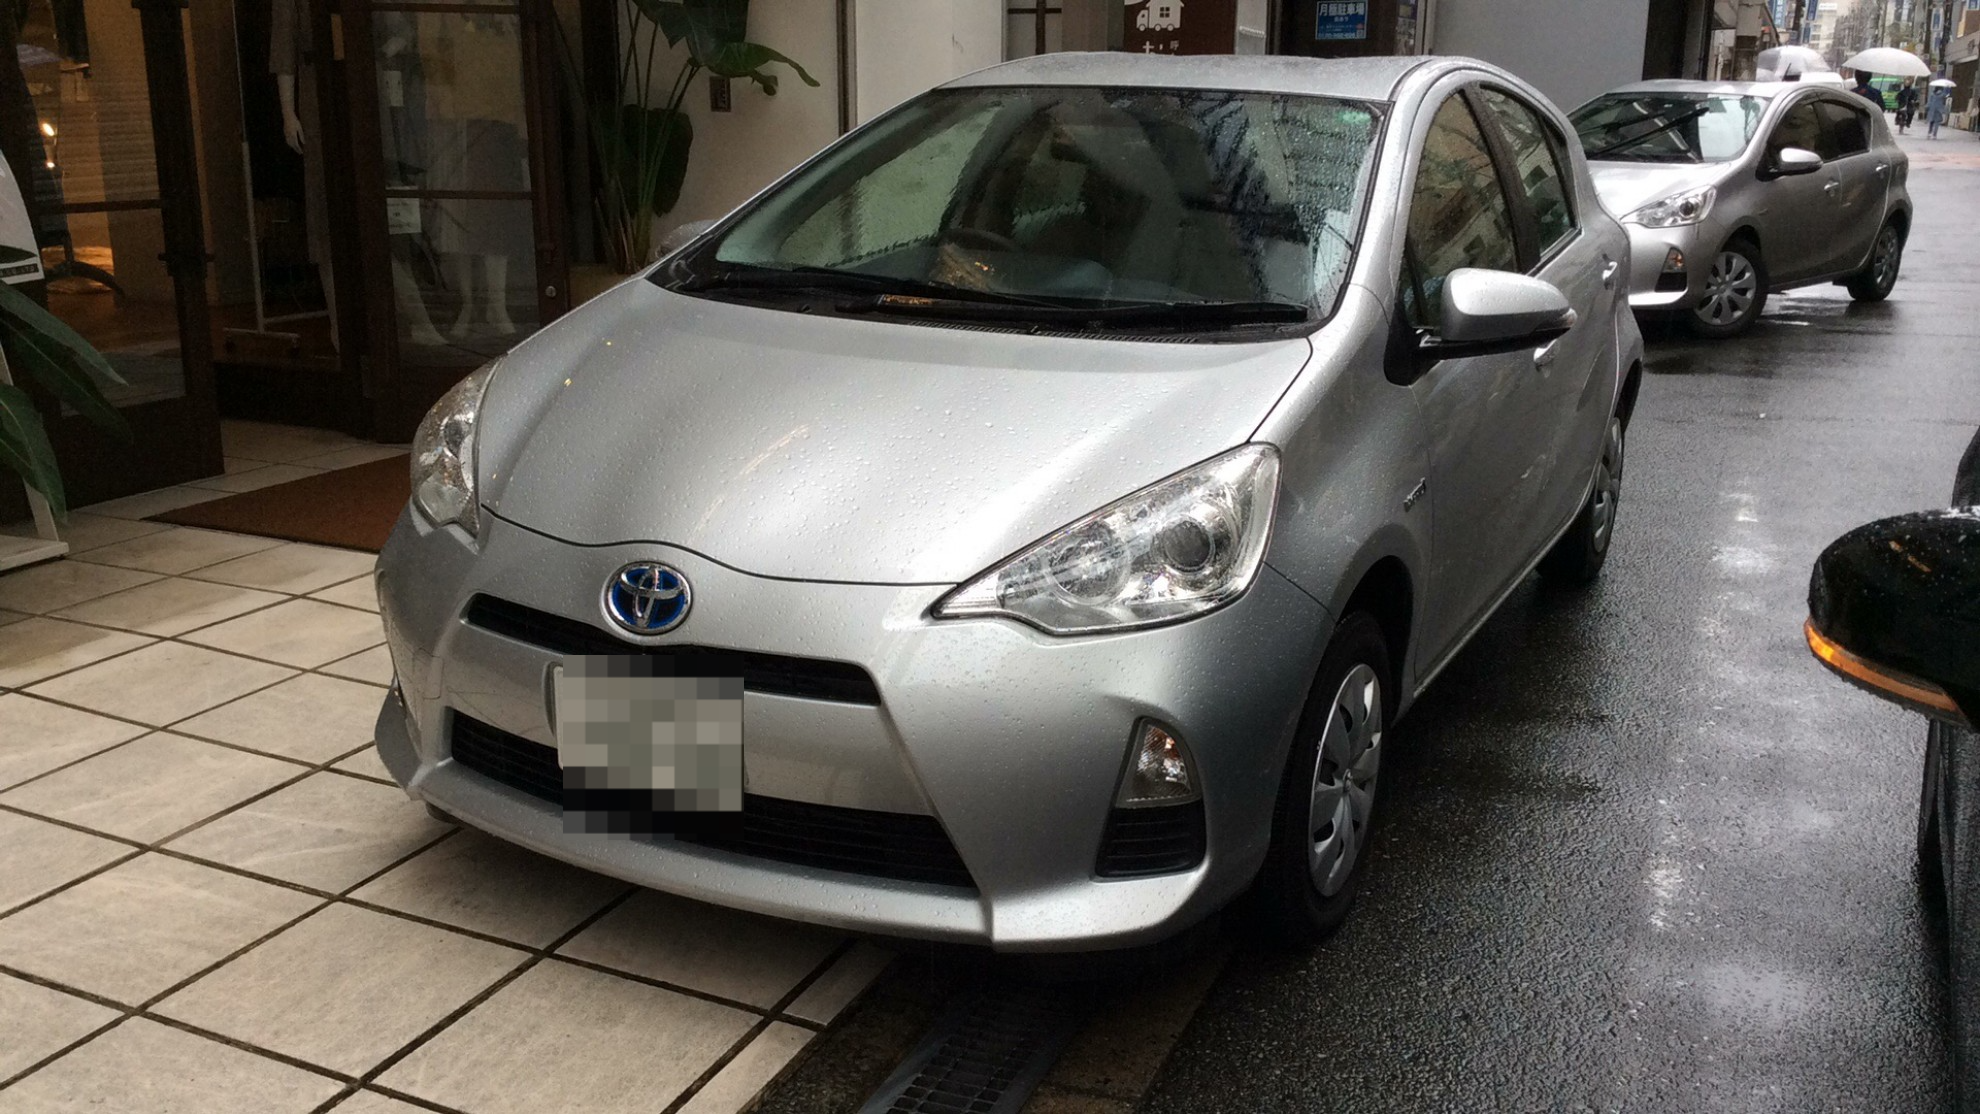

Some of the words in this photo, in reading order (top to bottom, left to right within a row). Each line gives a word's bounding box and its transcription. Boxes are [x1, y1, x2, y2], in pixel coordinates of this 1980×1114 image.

[1320, 2, 1365, 16] 月極駐車場
